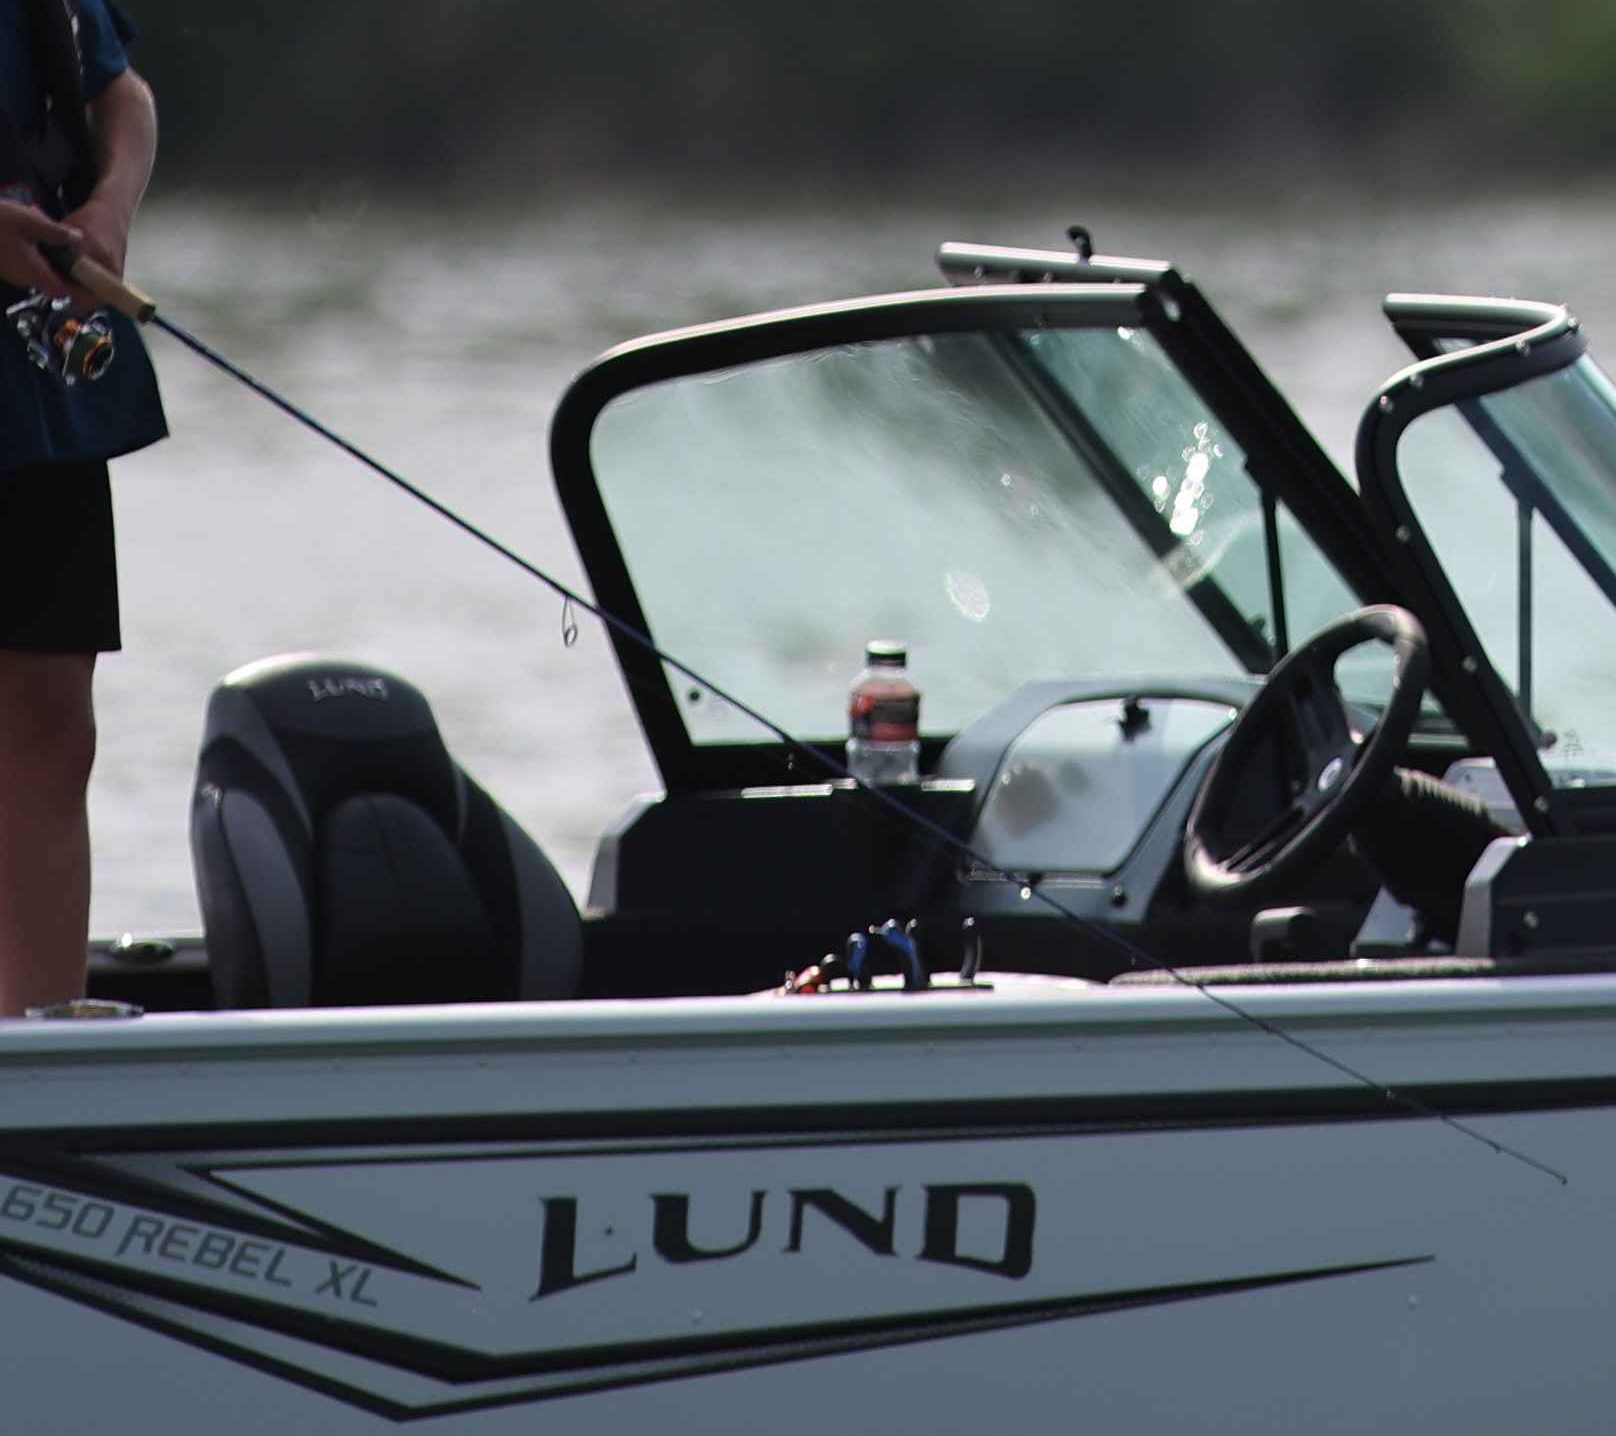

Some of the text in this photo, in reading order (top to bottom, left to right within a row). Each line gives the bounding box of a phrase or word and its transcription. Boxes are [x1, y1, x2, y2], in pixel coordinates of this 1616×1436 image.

[114, 1214, 292, 1287] REBEL
[315, 1260, 378, 1308] XL
[529, 1181, 1037, 1303] LUND
